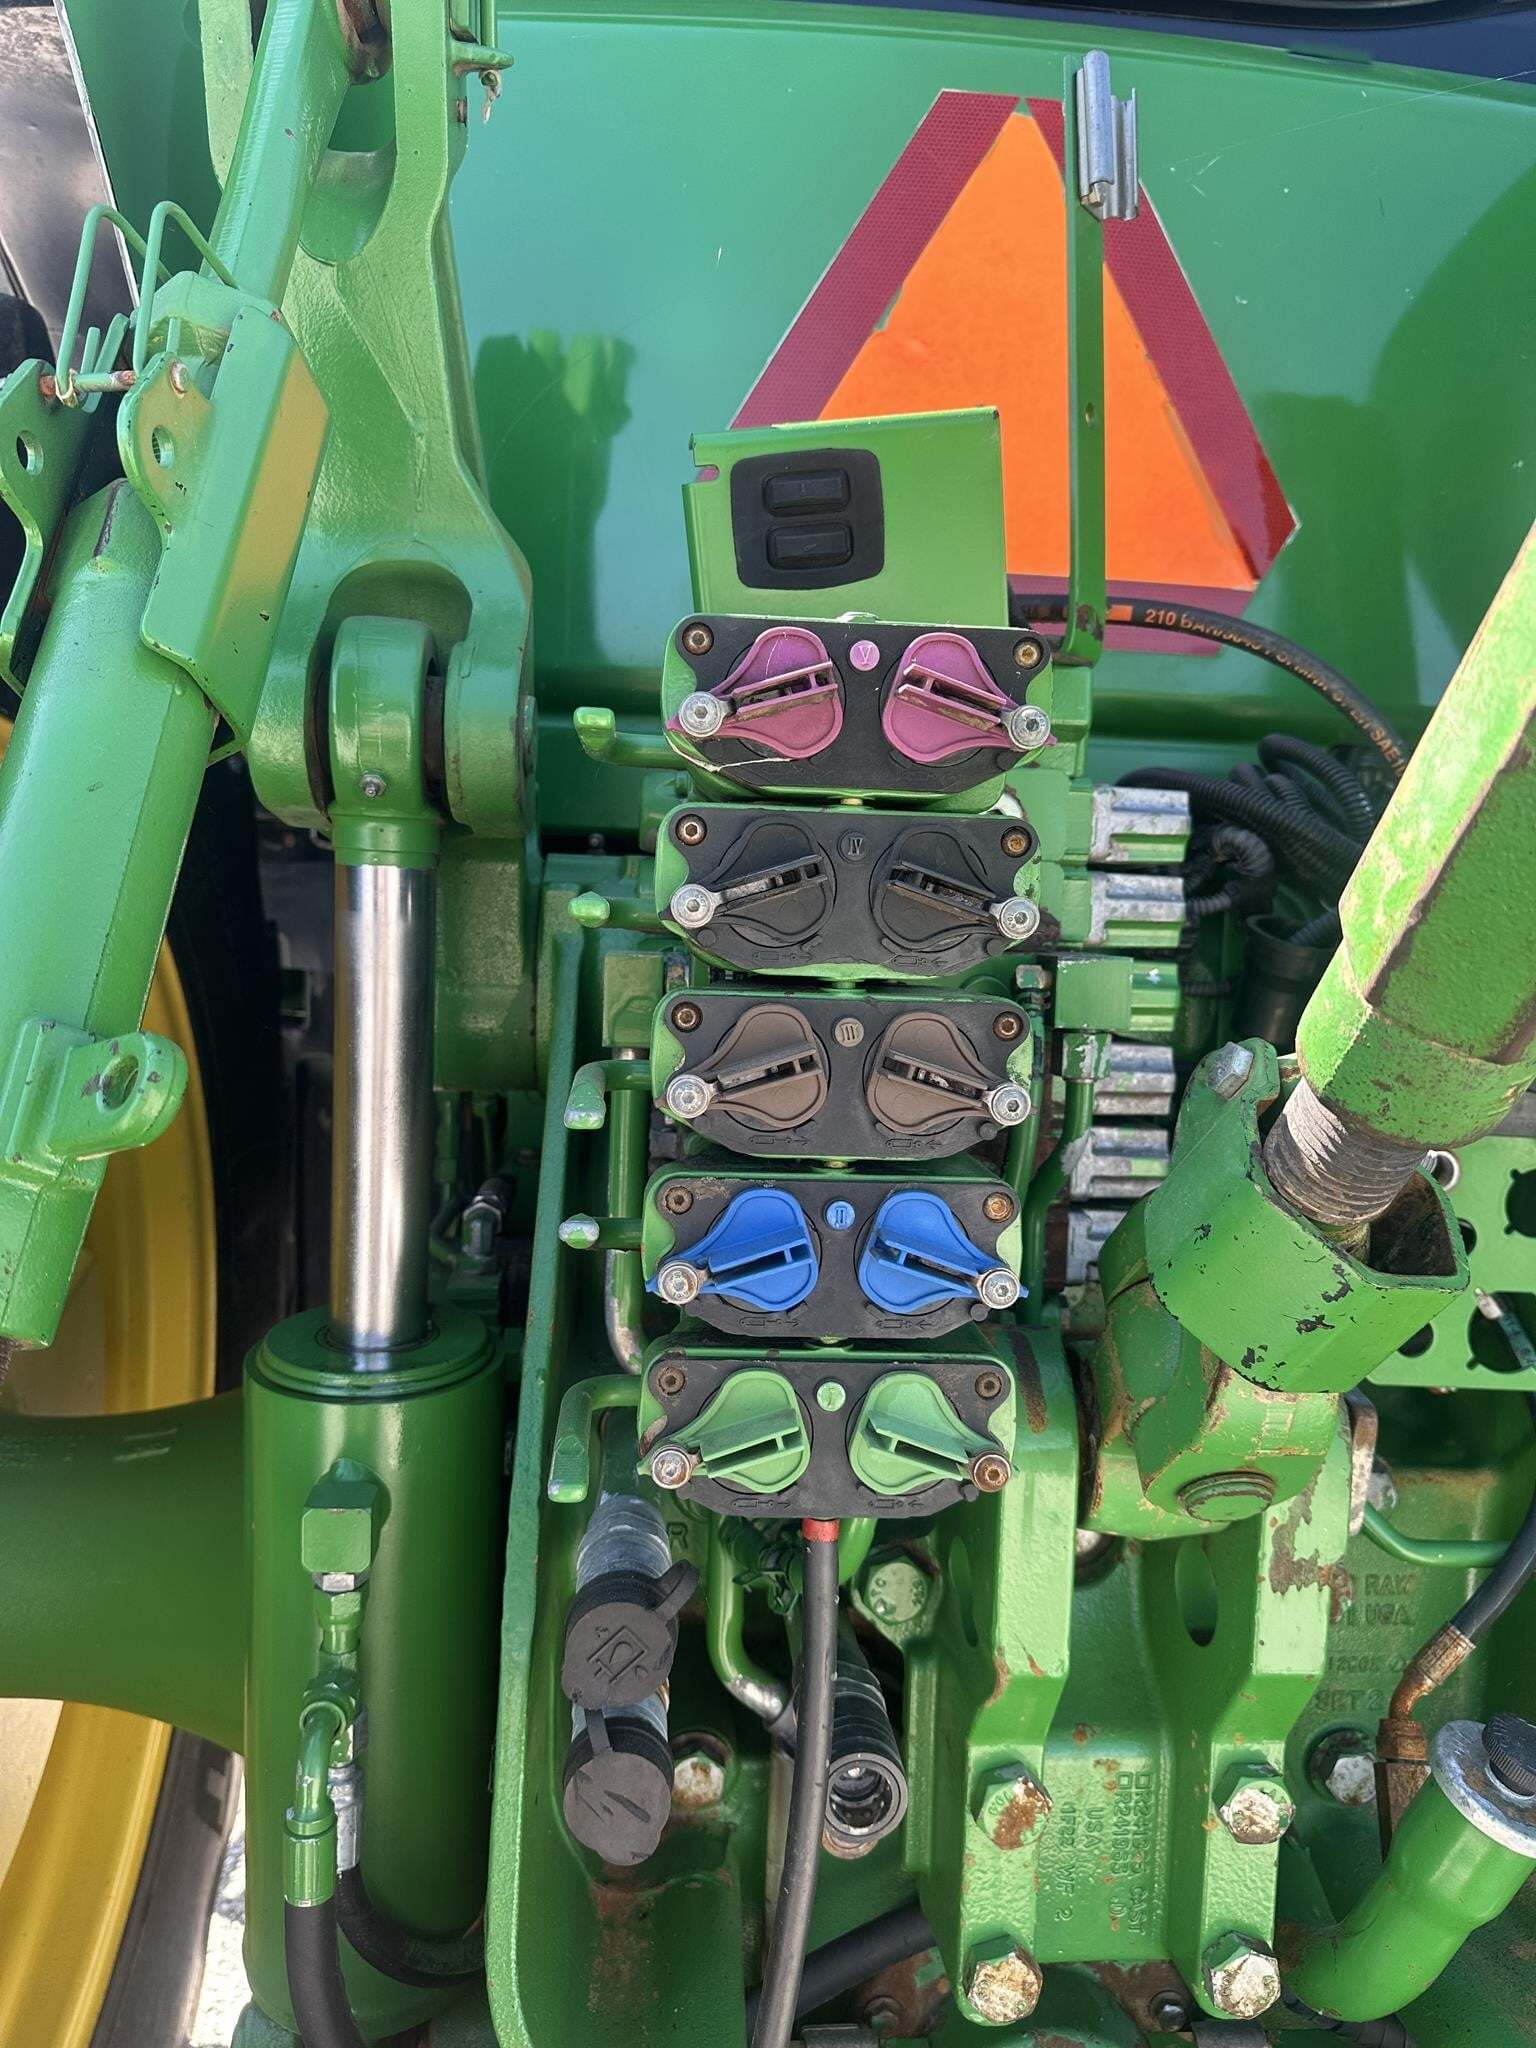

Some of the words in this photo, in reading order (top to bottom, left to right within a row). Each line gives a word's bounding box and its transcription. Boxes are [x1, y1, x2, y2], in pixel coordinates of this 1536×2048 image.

[1145, 608, 1176, 626] 210
[857, 645, 873, 665] V
[848, 837, 864, 856] IV
[840, 1023, 859, 1042] III
[1083, 1807, 1105, 1850] USA
[1127, 1885, 1148, 1935] CAST
